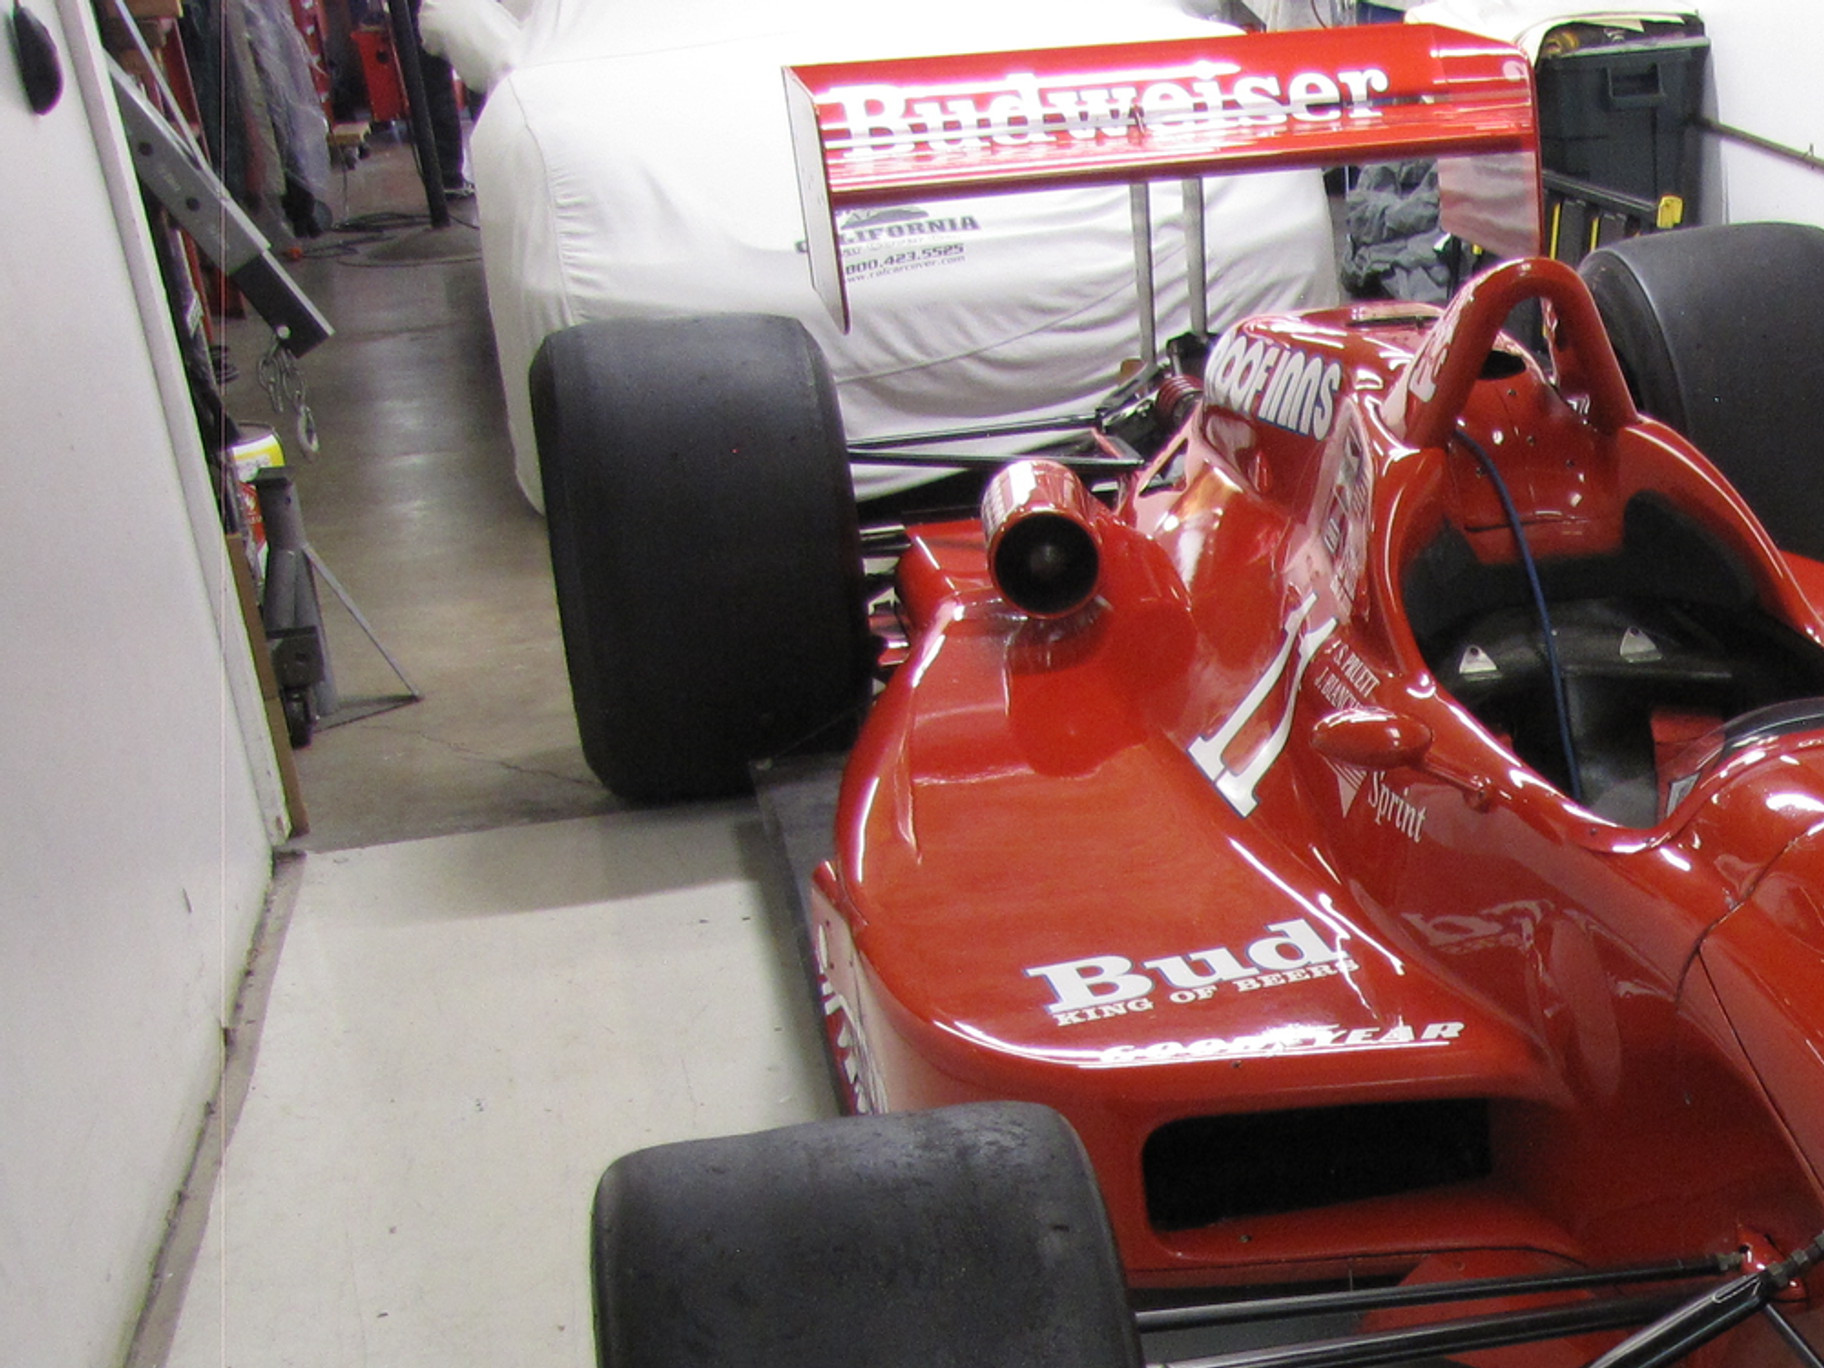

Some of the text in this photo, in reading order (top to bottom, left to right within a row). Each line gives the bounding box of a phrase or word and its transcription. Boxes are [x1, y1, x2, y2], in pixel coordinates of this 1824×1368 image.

[832, 64, 1389, 156] Budweiser
[1025, 918, 1349, 1014] Bud
[1053, 958, 1360, 1026] KING OF BEERS
